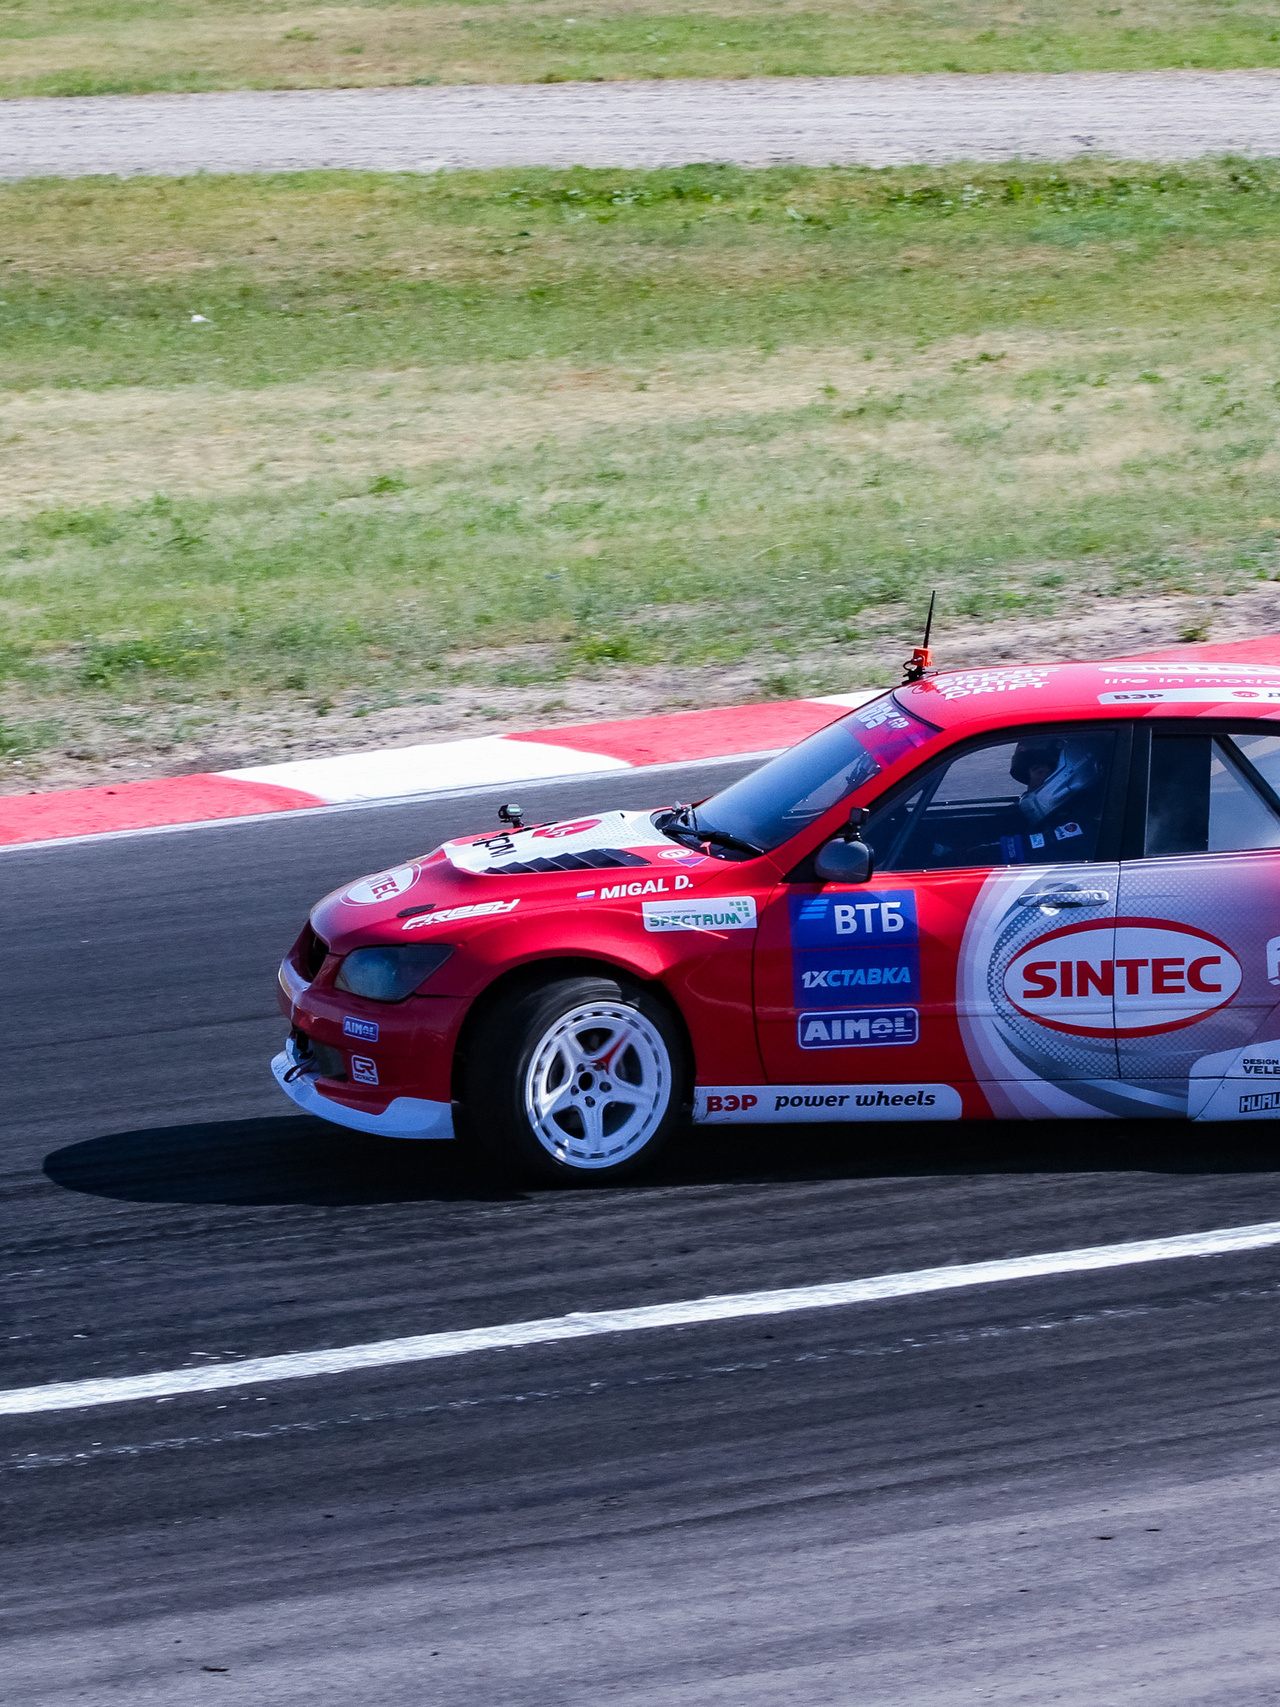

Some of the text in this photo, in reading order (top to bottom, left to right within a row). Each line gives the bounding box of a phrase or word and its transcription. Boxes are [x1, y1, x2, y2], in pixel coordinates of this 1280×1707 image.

[939, 677, 1041, 695] AUTO
[945, 682, 1051, 701] DRIFT
[600, 874, 694, 900] MIGAL D.
[649, 912, 742, 928] SPECTRUM
[834, 901, 904, 935] ВТБ
[1022, 956, 1222, 999] SINTEC
[344, 1020, 376, 1036] AIMOL
[803, 1017, 913, 1042] AIMOL
[707, 1094, 758, 1112] ВЭР
[774, 1091, 936, 1111] power wheels
